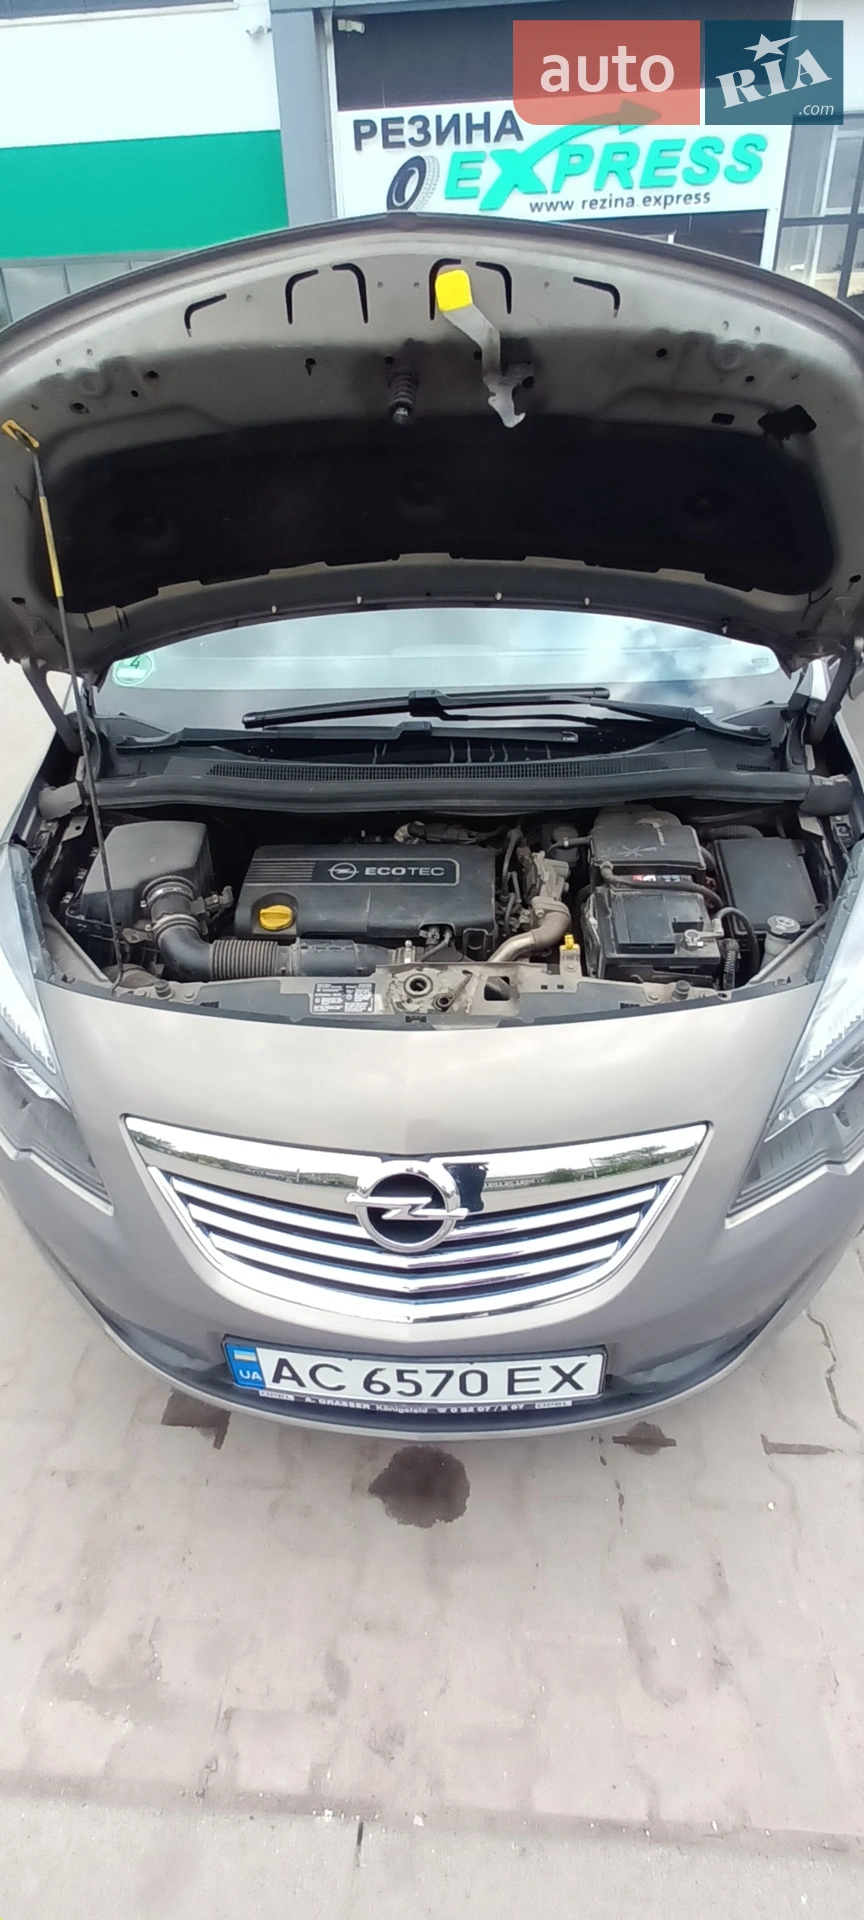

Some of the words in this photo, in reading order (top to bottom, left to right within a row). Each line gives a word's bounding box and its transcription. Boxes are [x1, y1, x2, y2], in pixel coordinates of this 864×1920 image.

[352, 110, 524, 152] РЕЗИНА
[444, 134, 768, 211] EXPRESS
[364, 867, 445, 876] ECOTEC
[239, 1369, 263, 1381] UA
[272, 1357, 346, 1391] AC
[362, 1368, 489, 1398] 6570
[506, 1361, 589, 1396] EX
[319, 1399, 371, 1409] GRASSER
